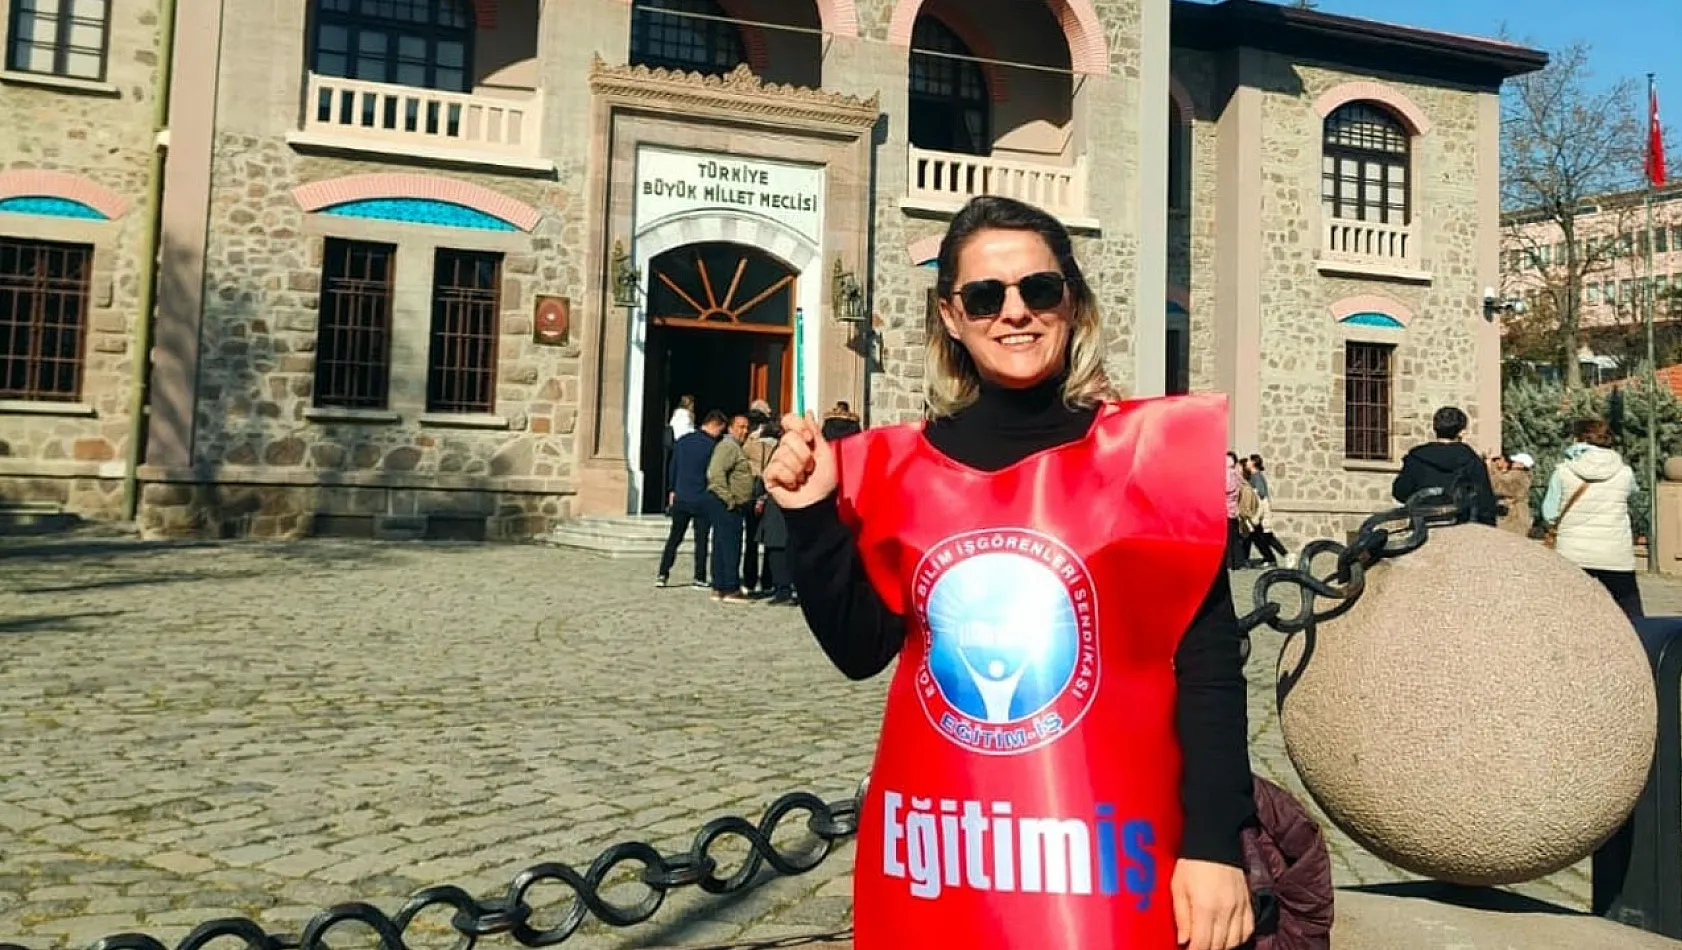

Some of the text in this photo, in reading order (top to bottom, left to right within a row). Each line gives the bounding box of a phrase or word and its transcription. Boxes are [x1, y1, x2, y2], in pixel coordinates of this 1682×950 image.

[698, 161, 769, 185] TÜRKİYE
[643, 179, 817, 212] BÜYÜK MİLLET MECLİSİ
[916, 533, 1095, 699] BİLİM İŞGÖRENLERİ SENDİKASI
